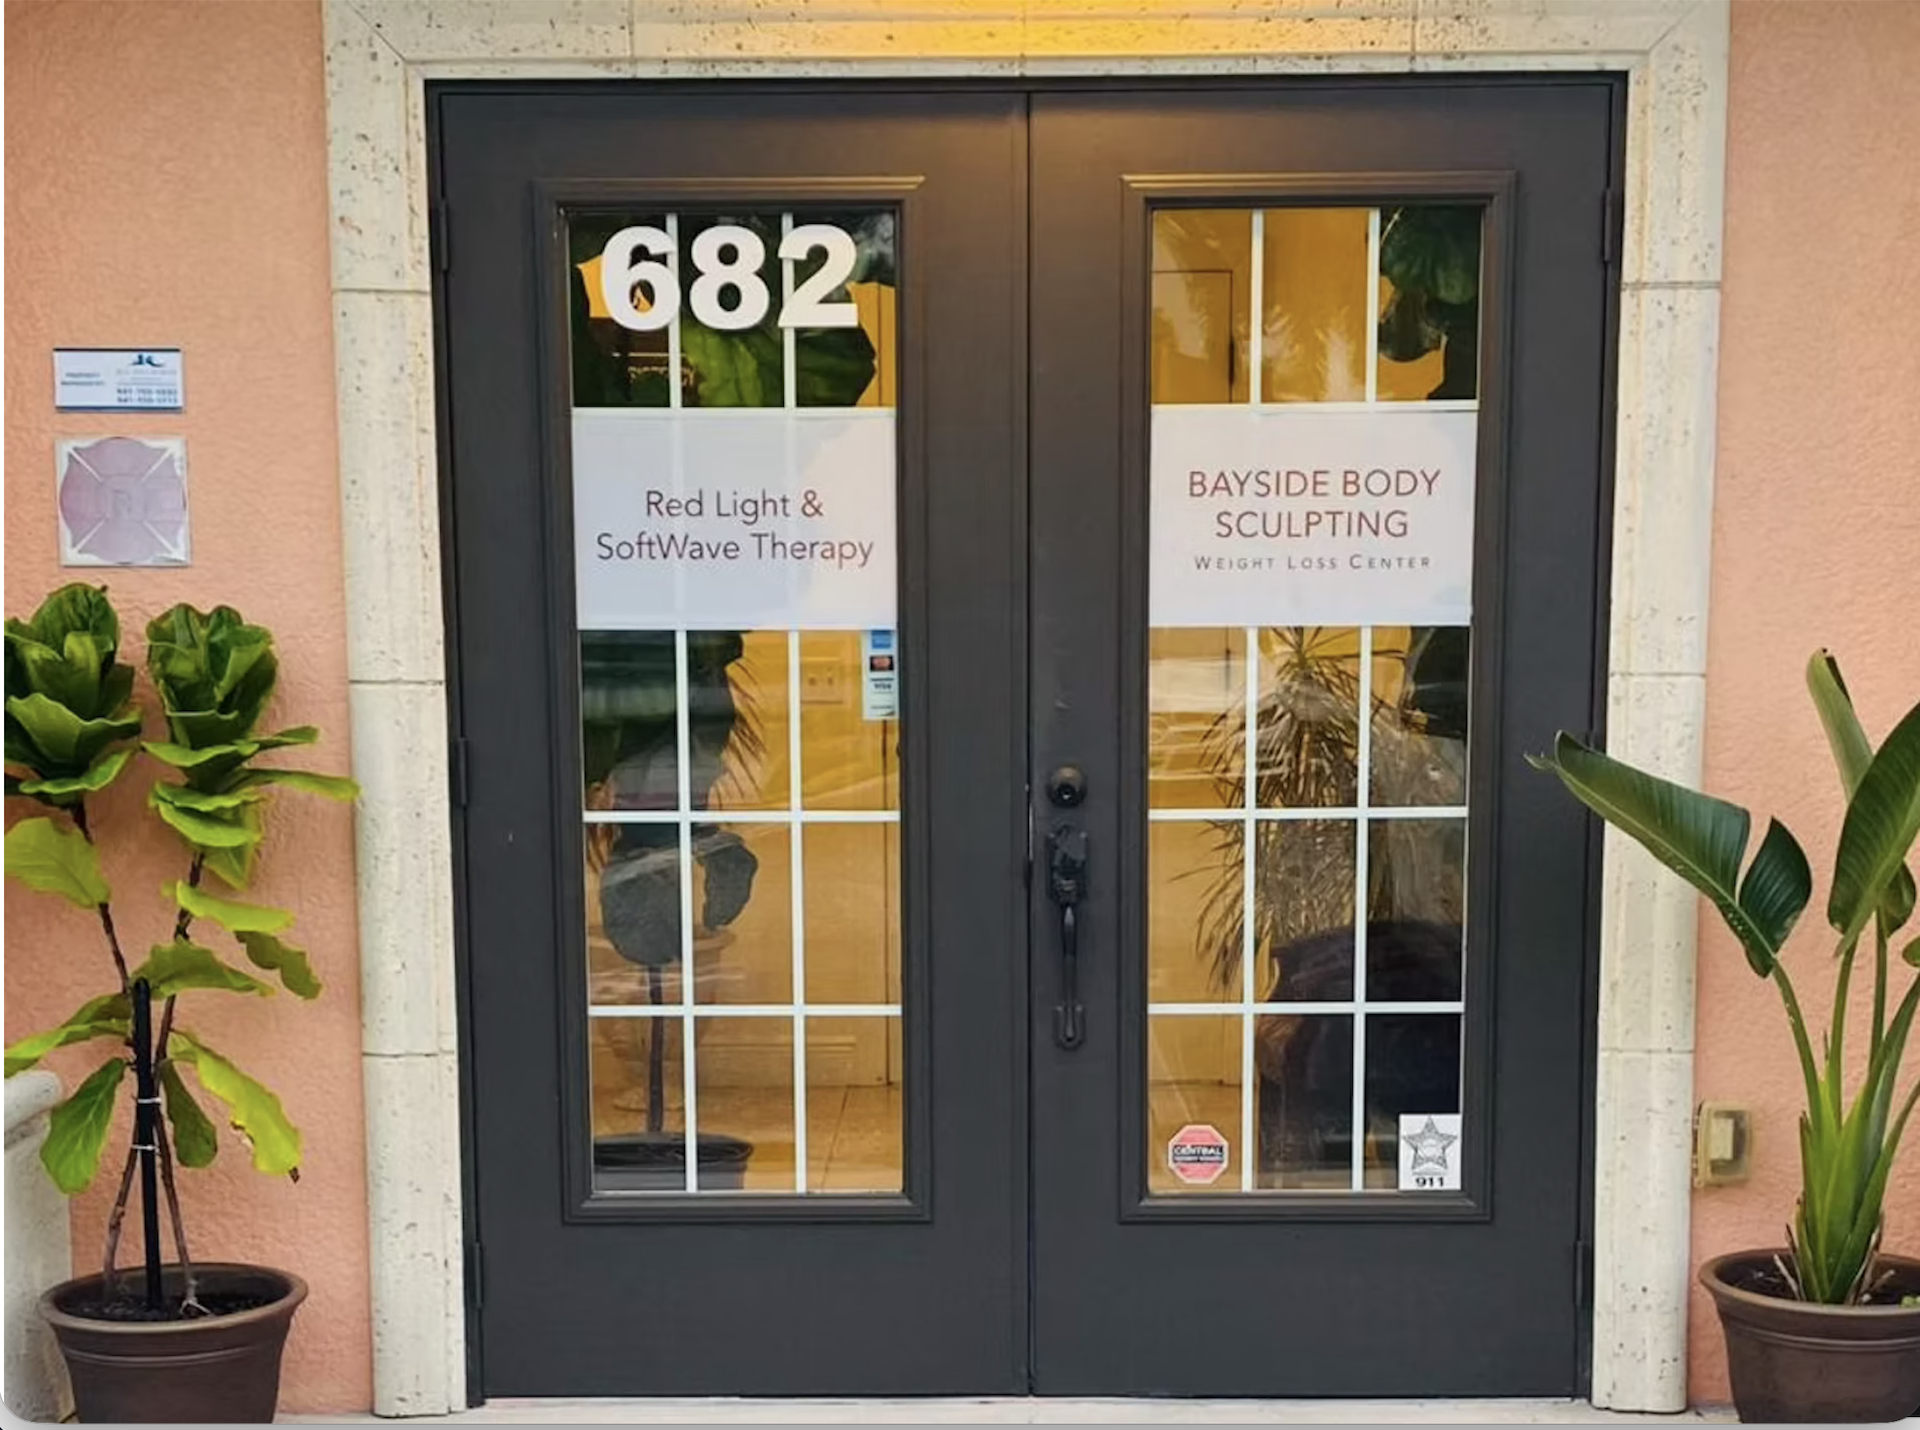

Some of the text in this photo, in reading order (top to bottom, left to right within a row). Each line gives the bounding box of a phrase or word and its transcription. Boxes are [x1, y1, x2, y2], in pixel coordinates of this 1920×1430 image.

[601, 223, 859, 332] 682
[1188, 469, 1441, 498] BAYSIDE BODY
[645, 488, 825, 525] Red Light &
[1215, 509, 1409, 539] SCULPTING
[596, 531, 875, 570] SoftWave Therapy
[1415, 1176, 1444, 1187] 911
